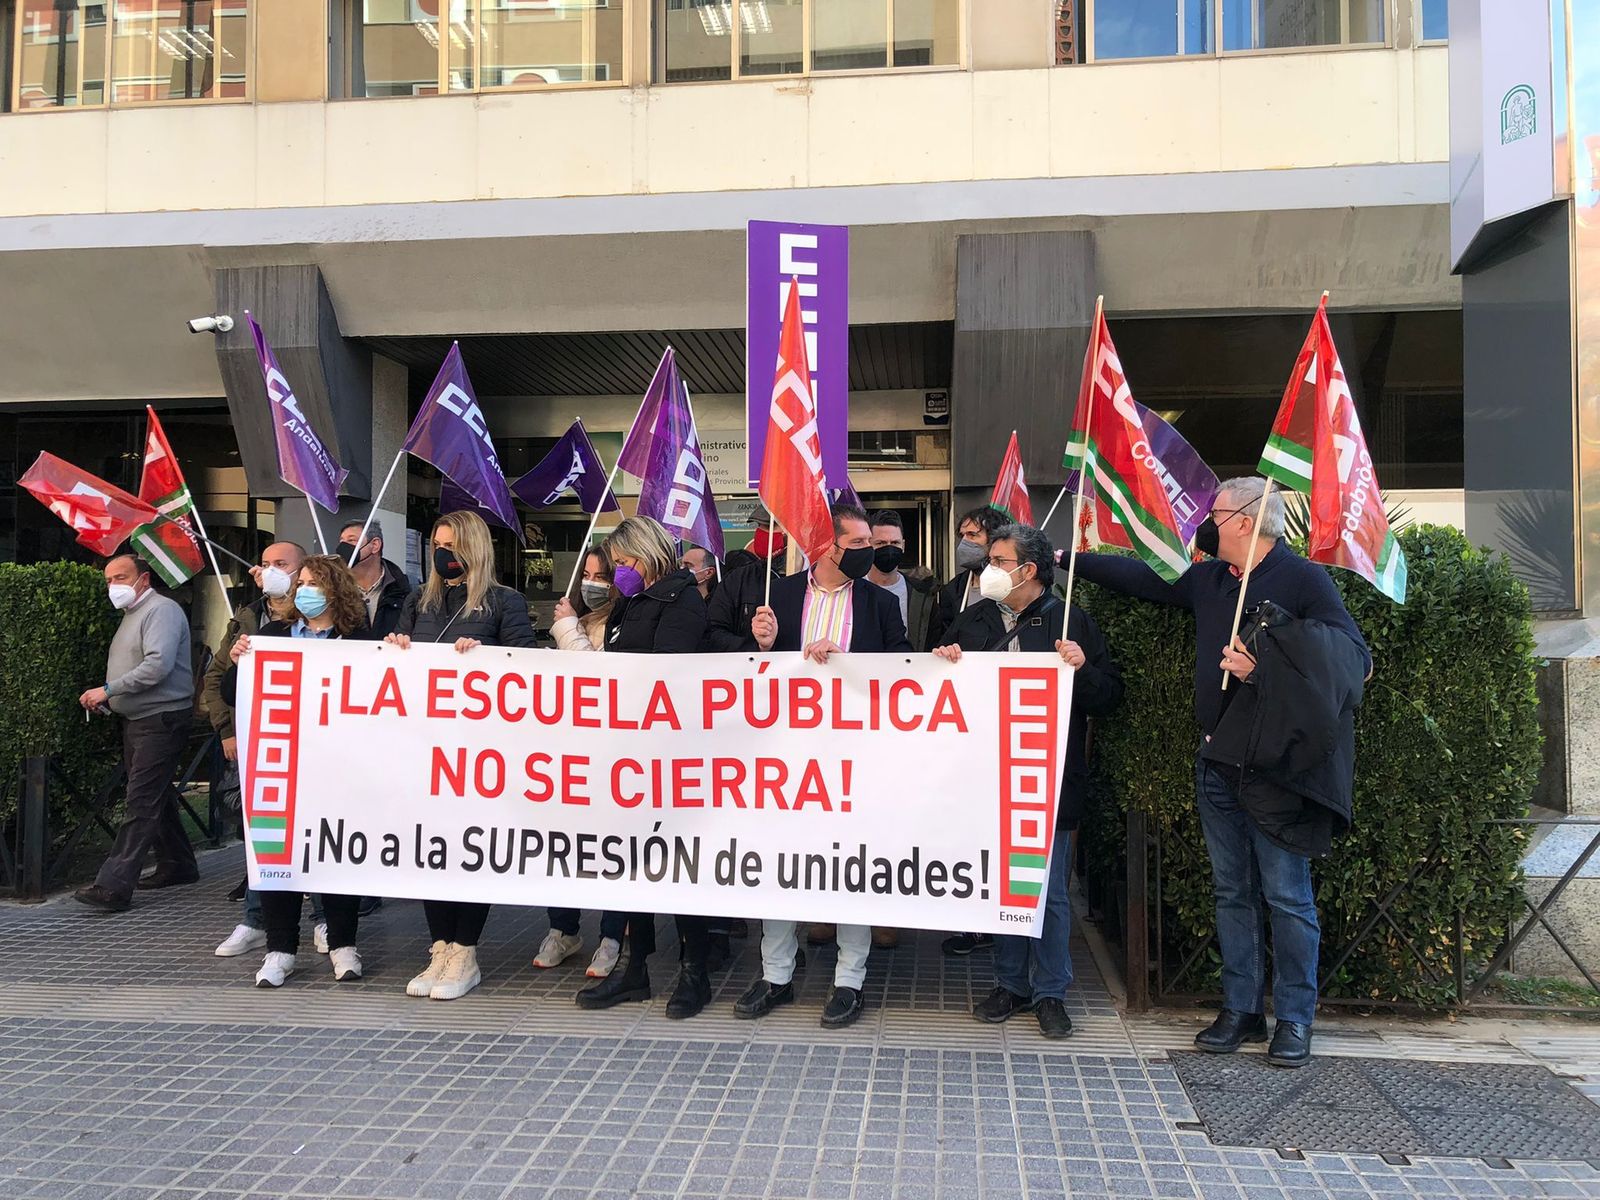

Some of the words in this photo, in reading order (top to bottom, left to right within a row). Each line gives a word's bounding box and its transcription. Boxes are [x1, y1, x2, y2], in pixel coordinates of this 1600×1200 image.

[700, 440, 746, 450] nistrativo
[703, 452, 719, 462] ino
[319, 666, 406, 726] ¡LA
[427, 668, 682, 731] ESCUELA
[702, 661, 968, 734] PÚBLICA
[252, 660, 294, 812] CCOO
[1009, 678, 1048, 849] CCOO
[430, 746, 506, 799] NO
[523, 751, 591, 807] SE
[610, 757, 853, 813] CIERRA!
[260, 868, 292, 879] ñanza
[302, 817, 368, 874] ¡No
[380, 833, 400, 867] a
[414, 823, 447, 870] la
[460, 821, 701, 884] SUPRESIÓN
[714, 838, 763, 888] de
[777, 842, 990, 900] unidades!
[999, 911, 1035, 923] Enseñ
